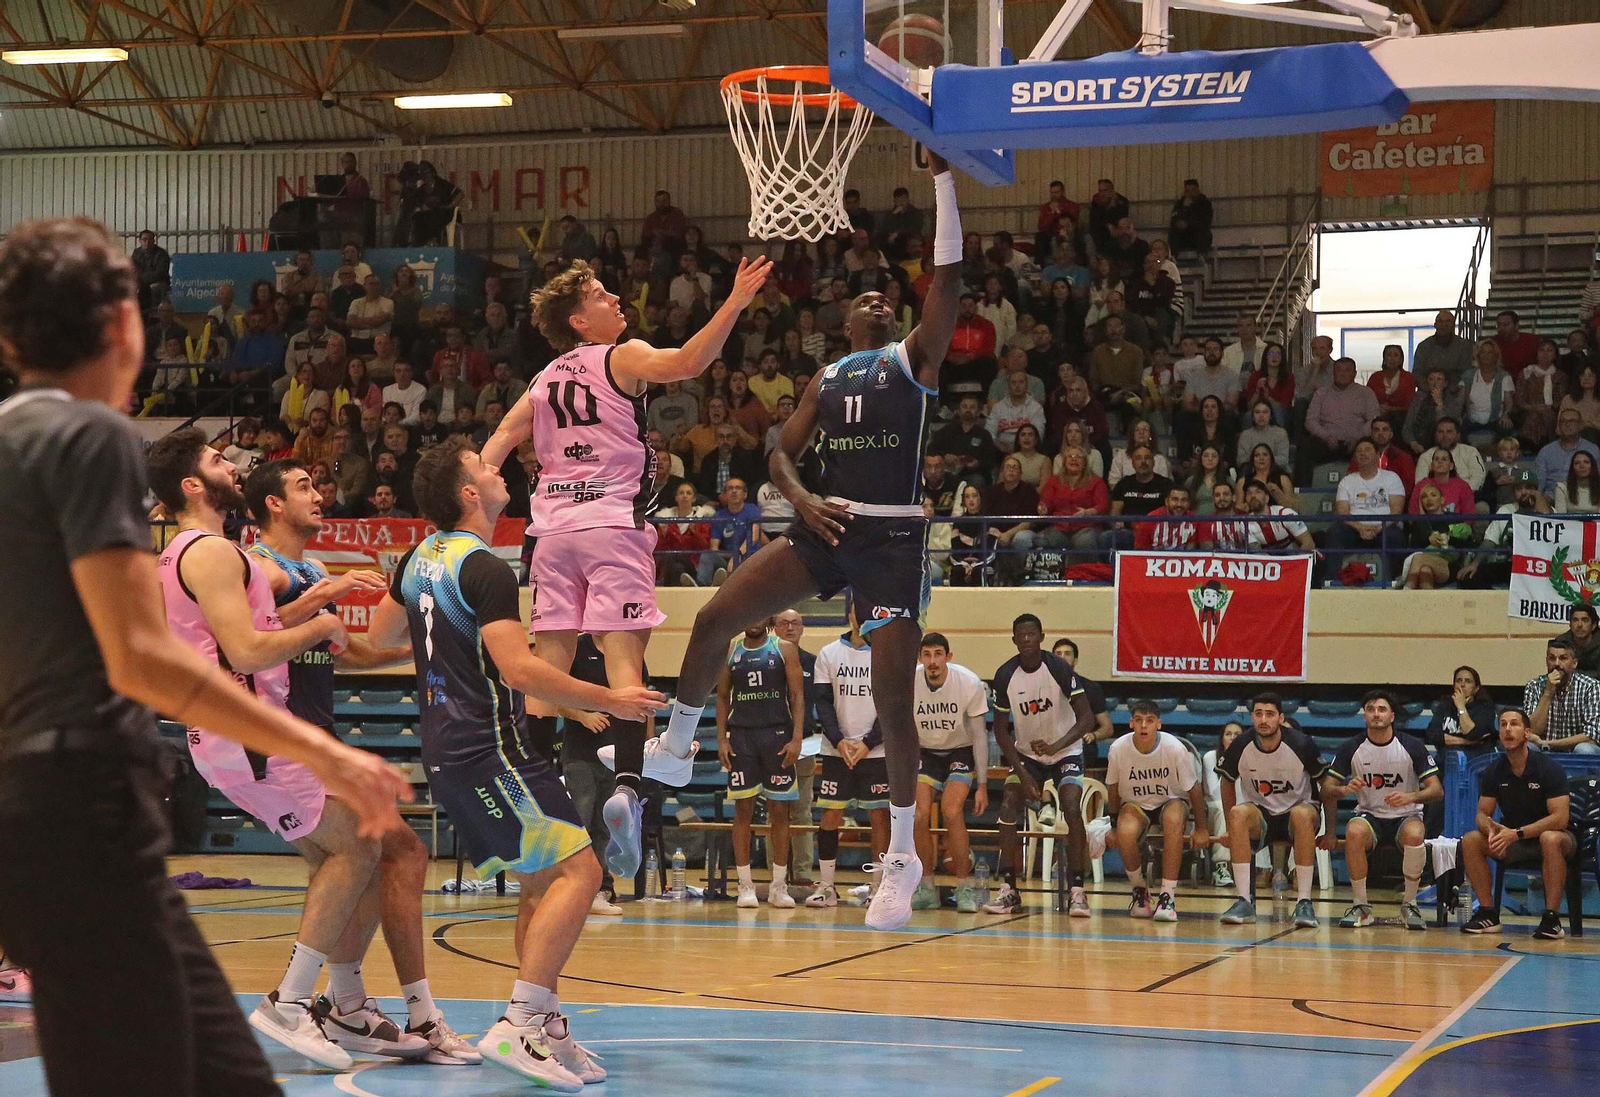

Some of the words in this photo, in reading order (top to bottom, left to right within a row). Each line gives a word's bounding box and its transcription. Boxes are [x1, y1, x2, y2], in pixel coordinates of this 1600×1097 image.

[1011, 78, 1117, 104] SPORT
[1118, 70, 1252, 103] SYSTEM
[1328, 136, 1485, 171] Cafetería
[174, 279, 234, 289] Ayuntamiento
[186, 288, 219, 299] Algeci
[547, 380, 602, 429] 10
[844, 395, 862, 423] 11
[1522, 471, 1529, 480] B
[763, 491, 784, 501] VAN
[316, 519, 393, 545] PEÑA
[1529, 520, 1566, 545] ACF
[1145, 558, 1282, 582] KOMANDO
[1526, 559, 1548, 574] 19
[836, 663, 870, 678] ÁNIM
[1142, 655, 1210, 671] FUENTE
[1213, 658, 1276, 673] NUEVA
[747, 670, 763, 687] 21
[737, 689, 780, 701] damex.io
[839, 684, 872, 696] RILEY
[917, 701, 958, 715] ÁNIMO
[920, 719, 956, 731] RILEY
[731, 771, 745, 787] 21
[1128, 766, 1170, 780] ÁNIMO
[820, 780, 839, 796] 55
[1132, 784, 1169, 796] RILEY
